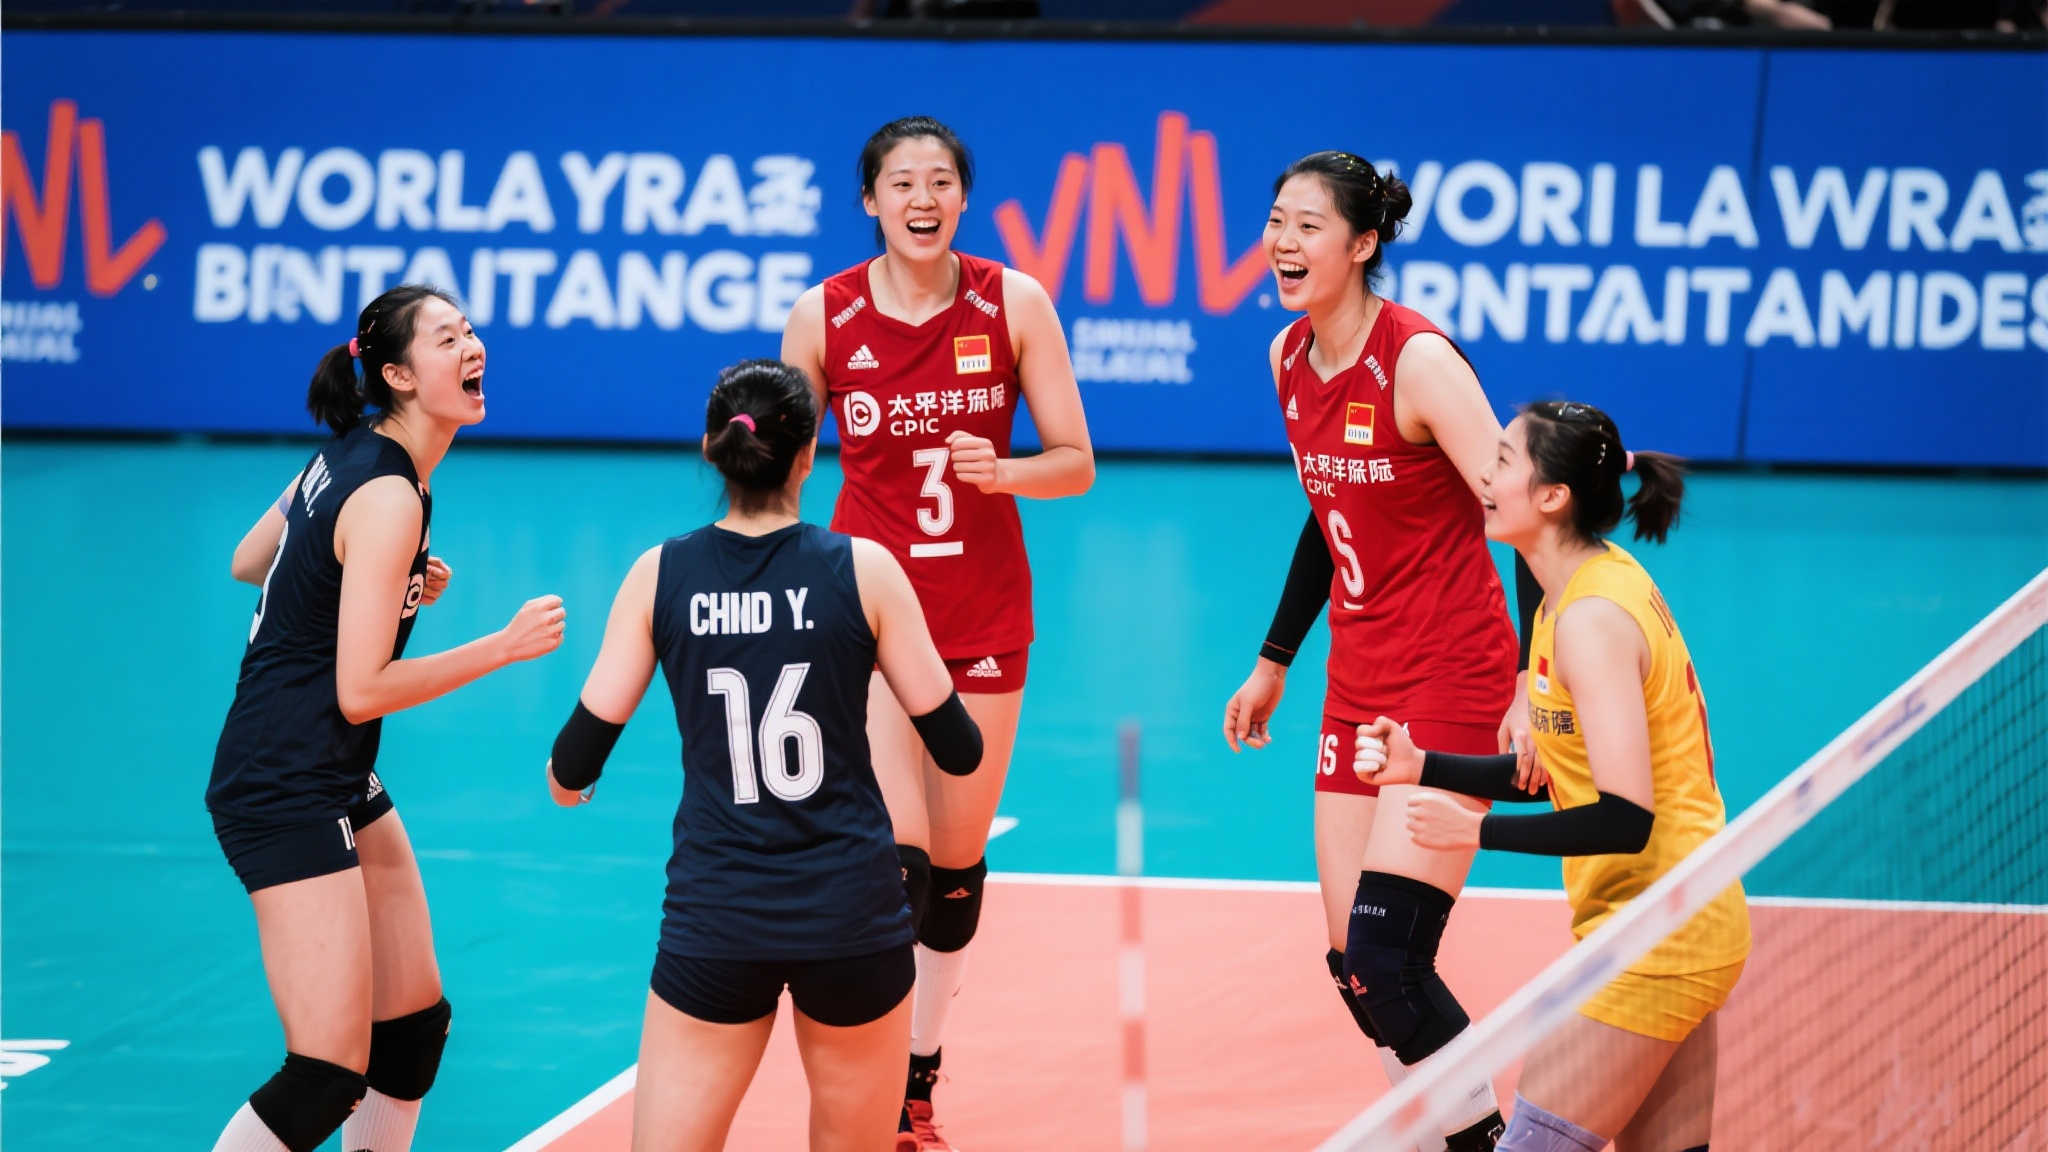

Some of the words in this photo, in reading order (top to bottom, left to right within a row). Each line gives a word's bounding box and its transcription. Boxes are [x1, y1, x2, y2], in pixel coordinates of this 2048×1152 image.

[198, 145, 556, 233] WORLA
[993, 109, 1274, 314] VNL
[889, 417, 940, 436] CPIC
[912, 447, 955, 537] 3
[784, 586, 815, 631] Y.
[706, 662, 825, 804] 16
